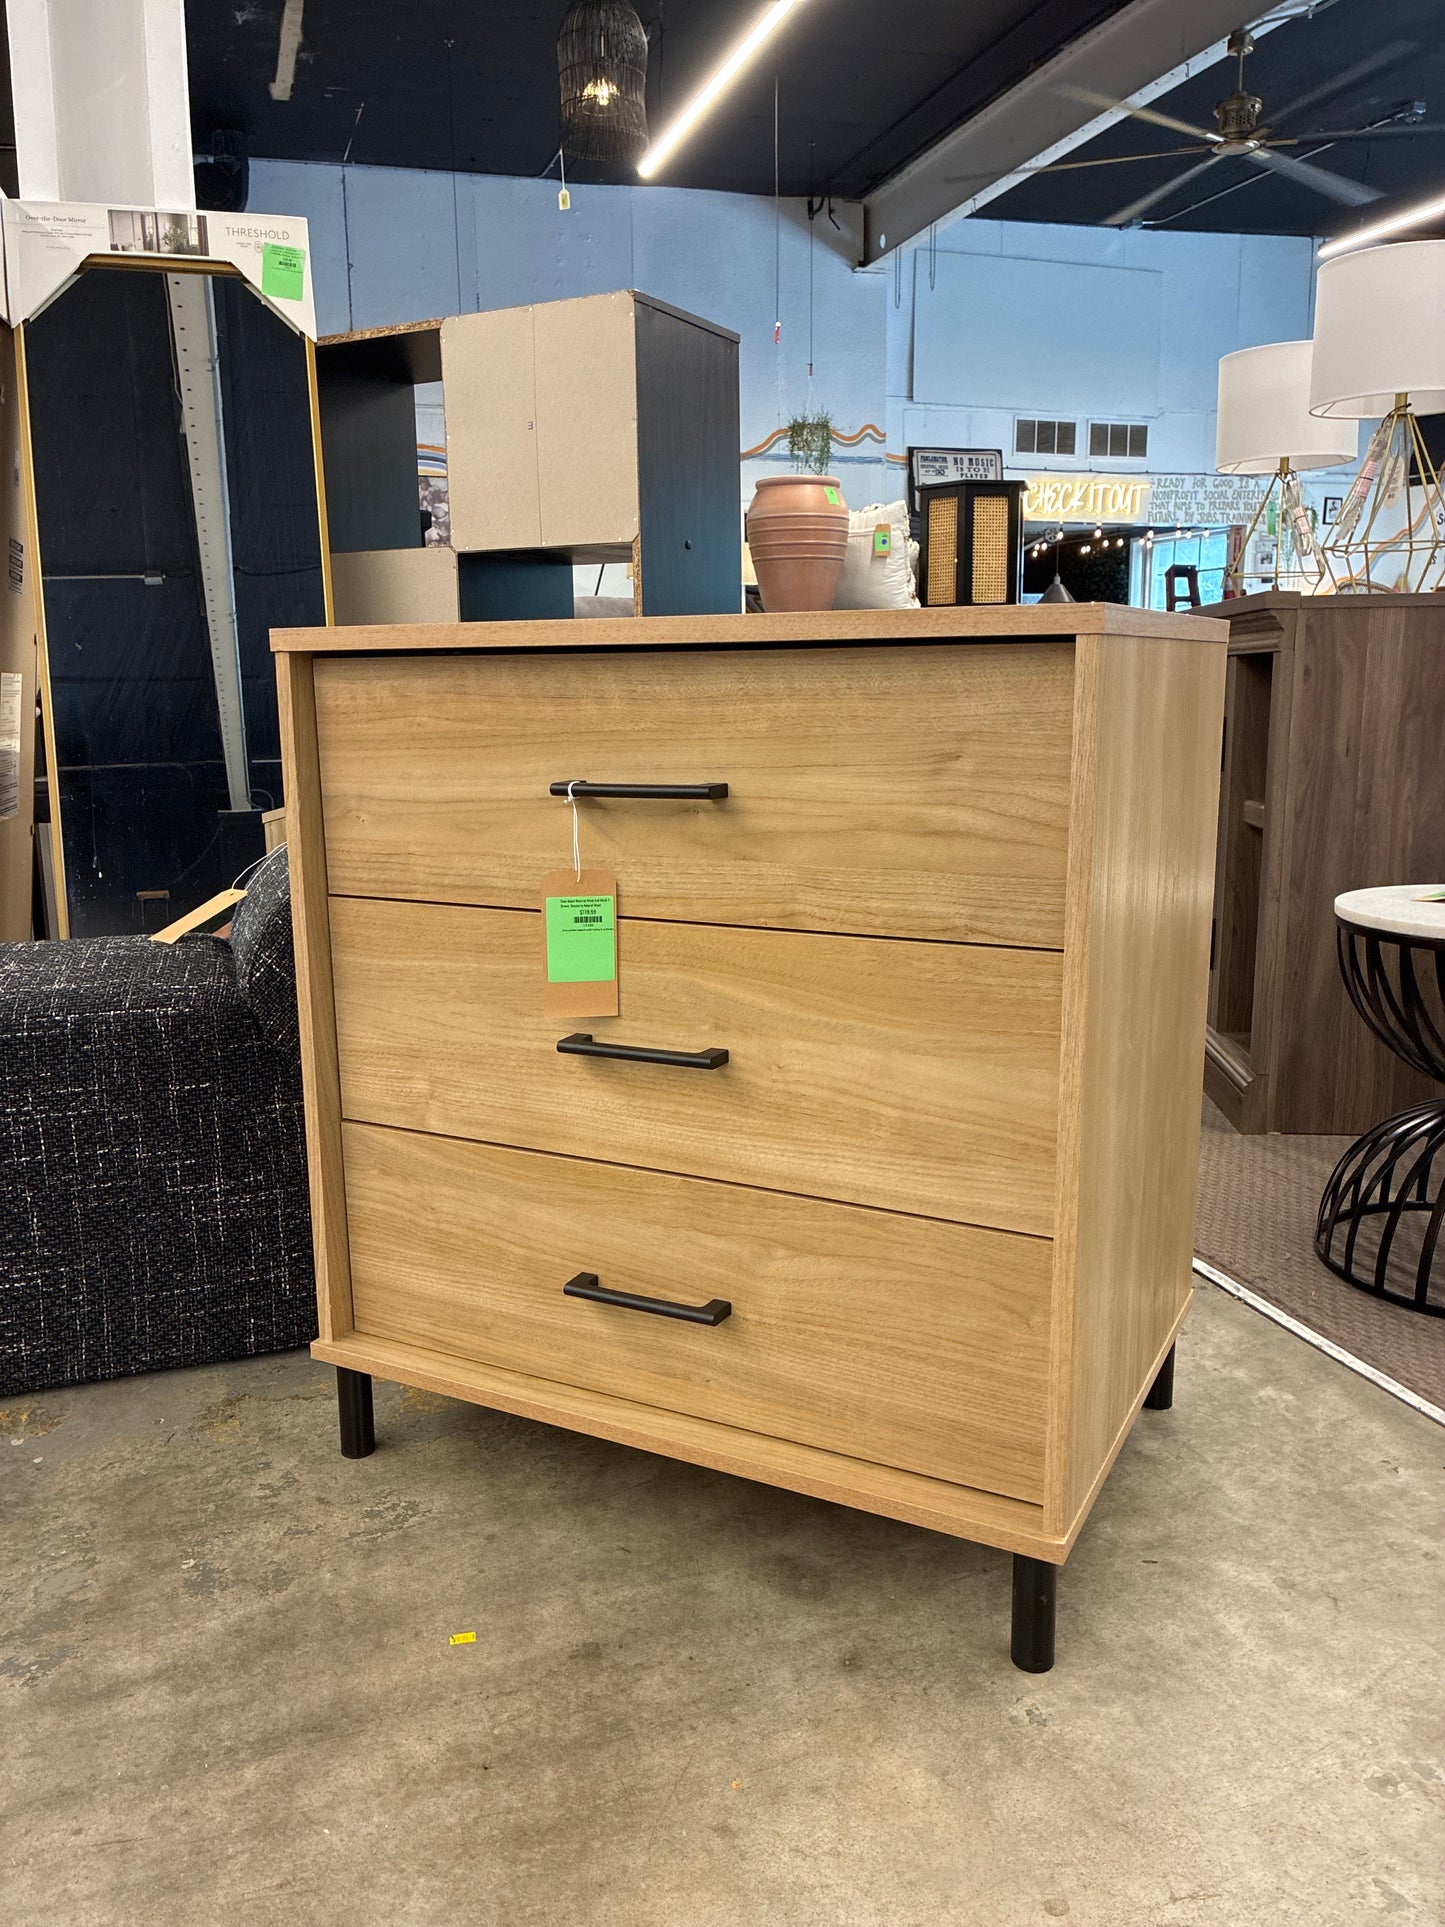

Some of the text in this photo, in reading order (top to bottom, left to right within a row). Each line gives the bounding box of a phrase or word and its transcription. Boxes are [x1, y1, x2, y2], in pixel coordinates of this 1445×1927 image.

[25, 214, 67, 223] Over-the-Door
[225, 226, 290, 240] THRESHOLD
[953, 457, 995, 467] NO MUSIC
[1157, 477, 1260, 489] READY FOR GOOD IS A
[1023, 481, 1150, 516] CHECK IT OUT
[1152, 490, 1199, 501] NONPROFIT
[1203, 490, 1229, 501] SOCIAL
[1149, 501, 1170, 511] THAT
[1174, 501, 1192, 511] AIMS
[1194, 502, 1206, 511] TO
[1209, 500, 1240, 511] PREPARE
[1184, 510, 1195, 523] BY
